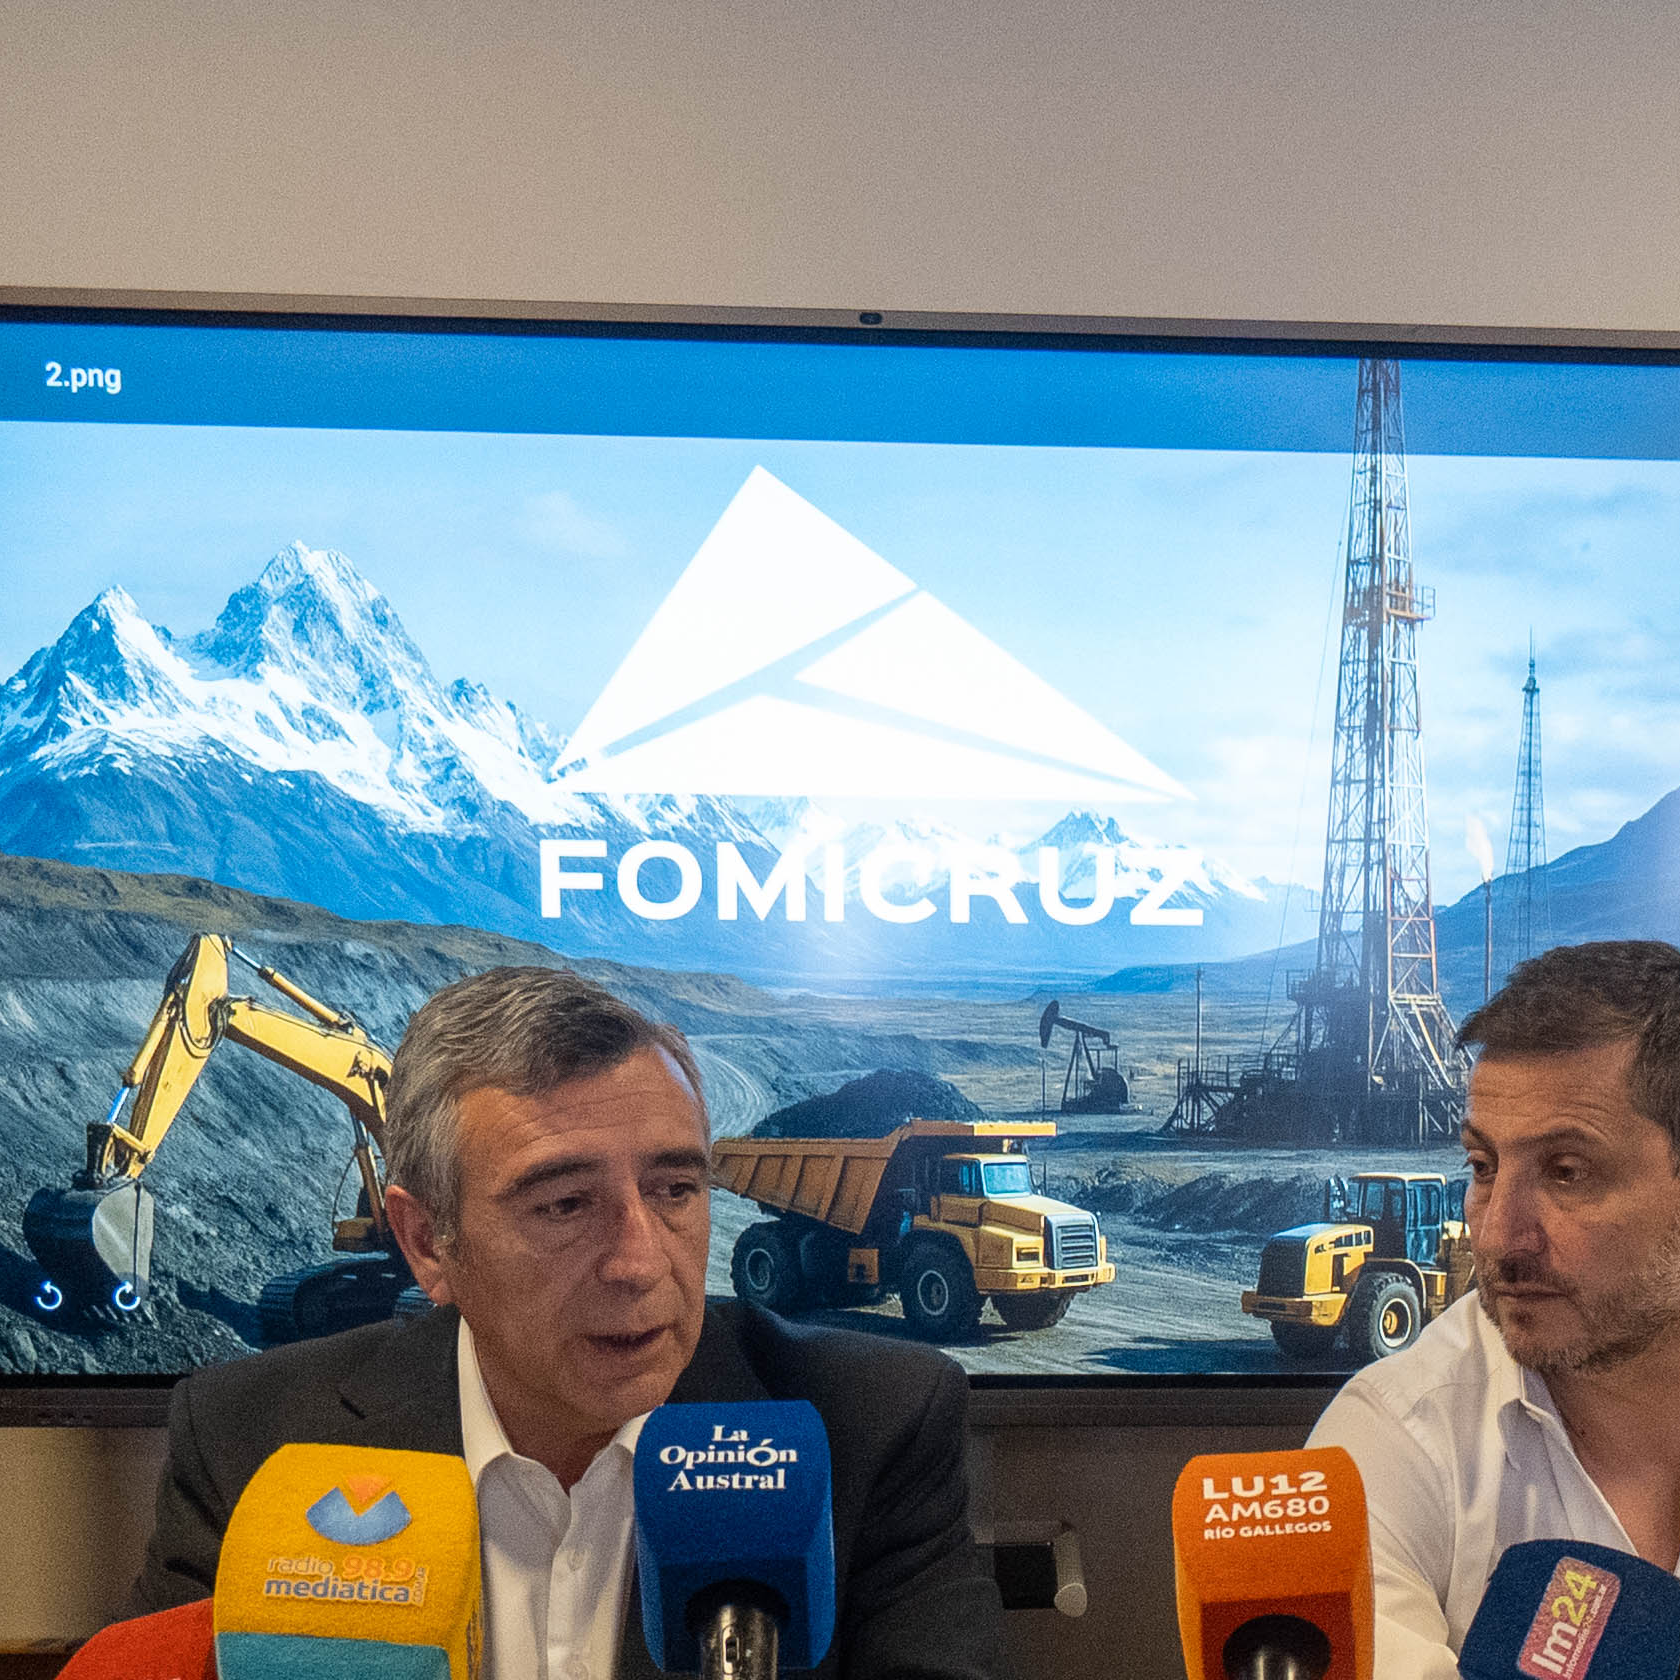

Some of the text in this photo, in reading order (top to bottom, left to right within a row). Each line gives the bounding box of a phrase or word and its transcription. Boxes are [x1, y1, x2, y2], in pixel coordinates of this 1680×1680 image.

[45, 361, 122, 394] 2.png
[538, 838, 1204, 926] FOMICRUZ
[711, 1425, 749, 1442] La
[667, 1468, 787, 1491] Austral
[1202, 1471, 1327, 1500] LU12
[1205, 1495, 1330, 1523] AM680
[1204, 1520, 1332, 1540] RÍO GALLEGOS
[268, 1555, 416, 1582] radio 98.9
[265, 1577, 410, 1603] mediatica
